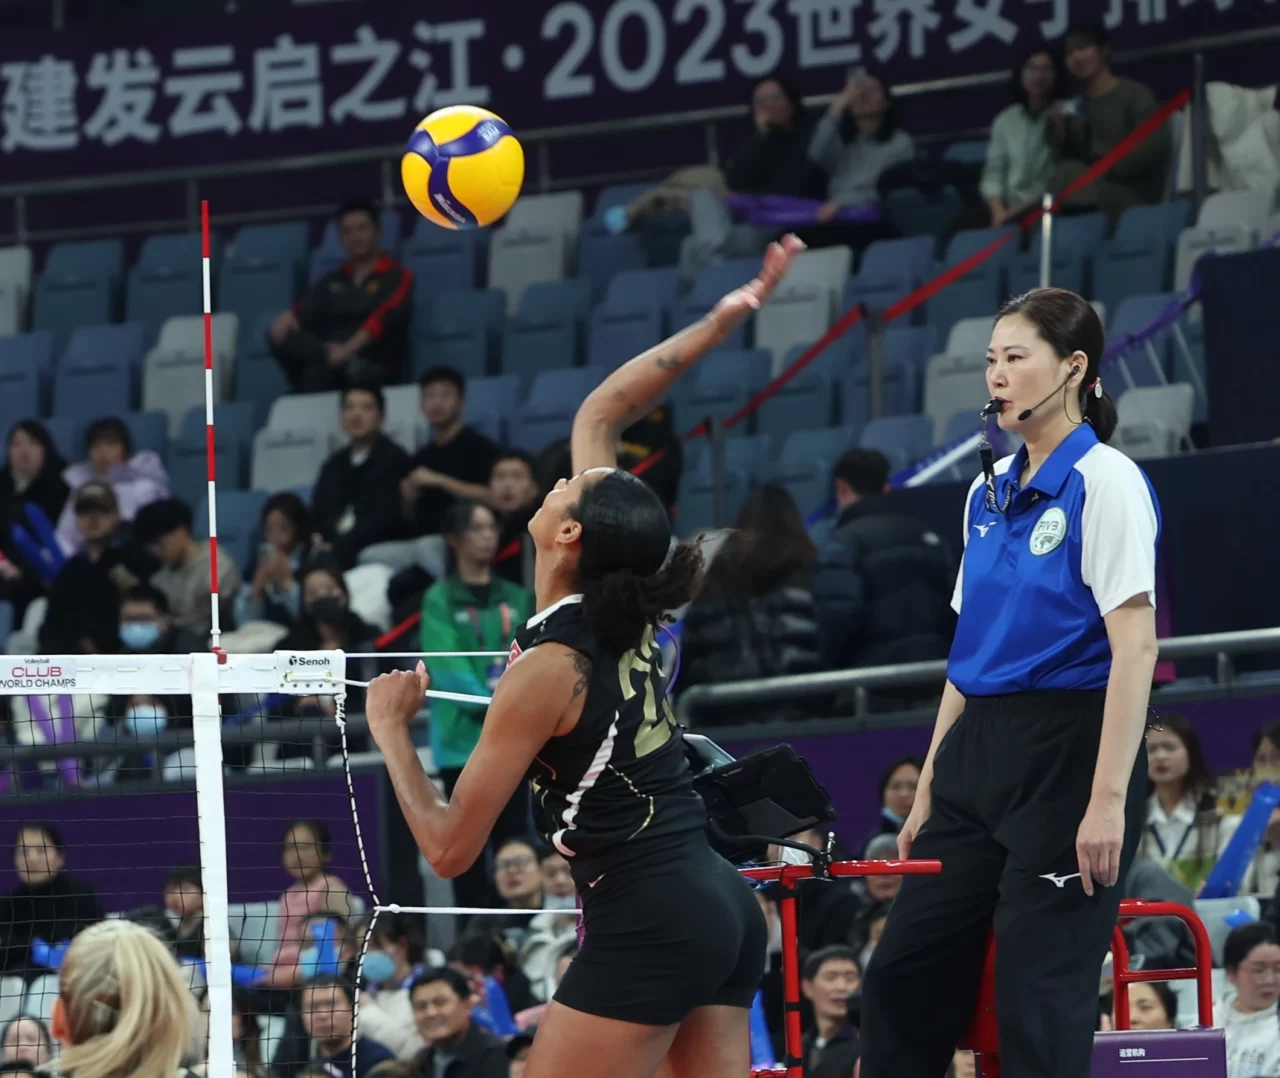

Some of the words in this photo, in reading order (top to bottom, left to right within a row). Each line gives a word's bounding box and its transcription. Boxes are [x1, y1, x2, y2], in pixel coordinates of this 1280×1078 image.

[298, 656, 330, 667] Senoh
[11, 666, 62, 678] CLUB
[34, 678, 76, 688] CHAMPS
